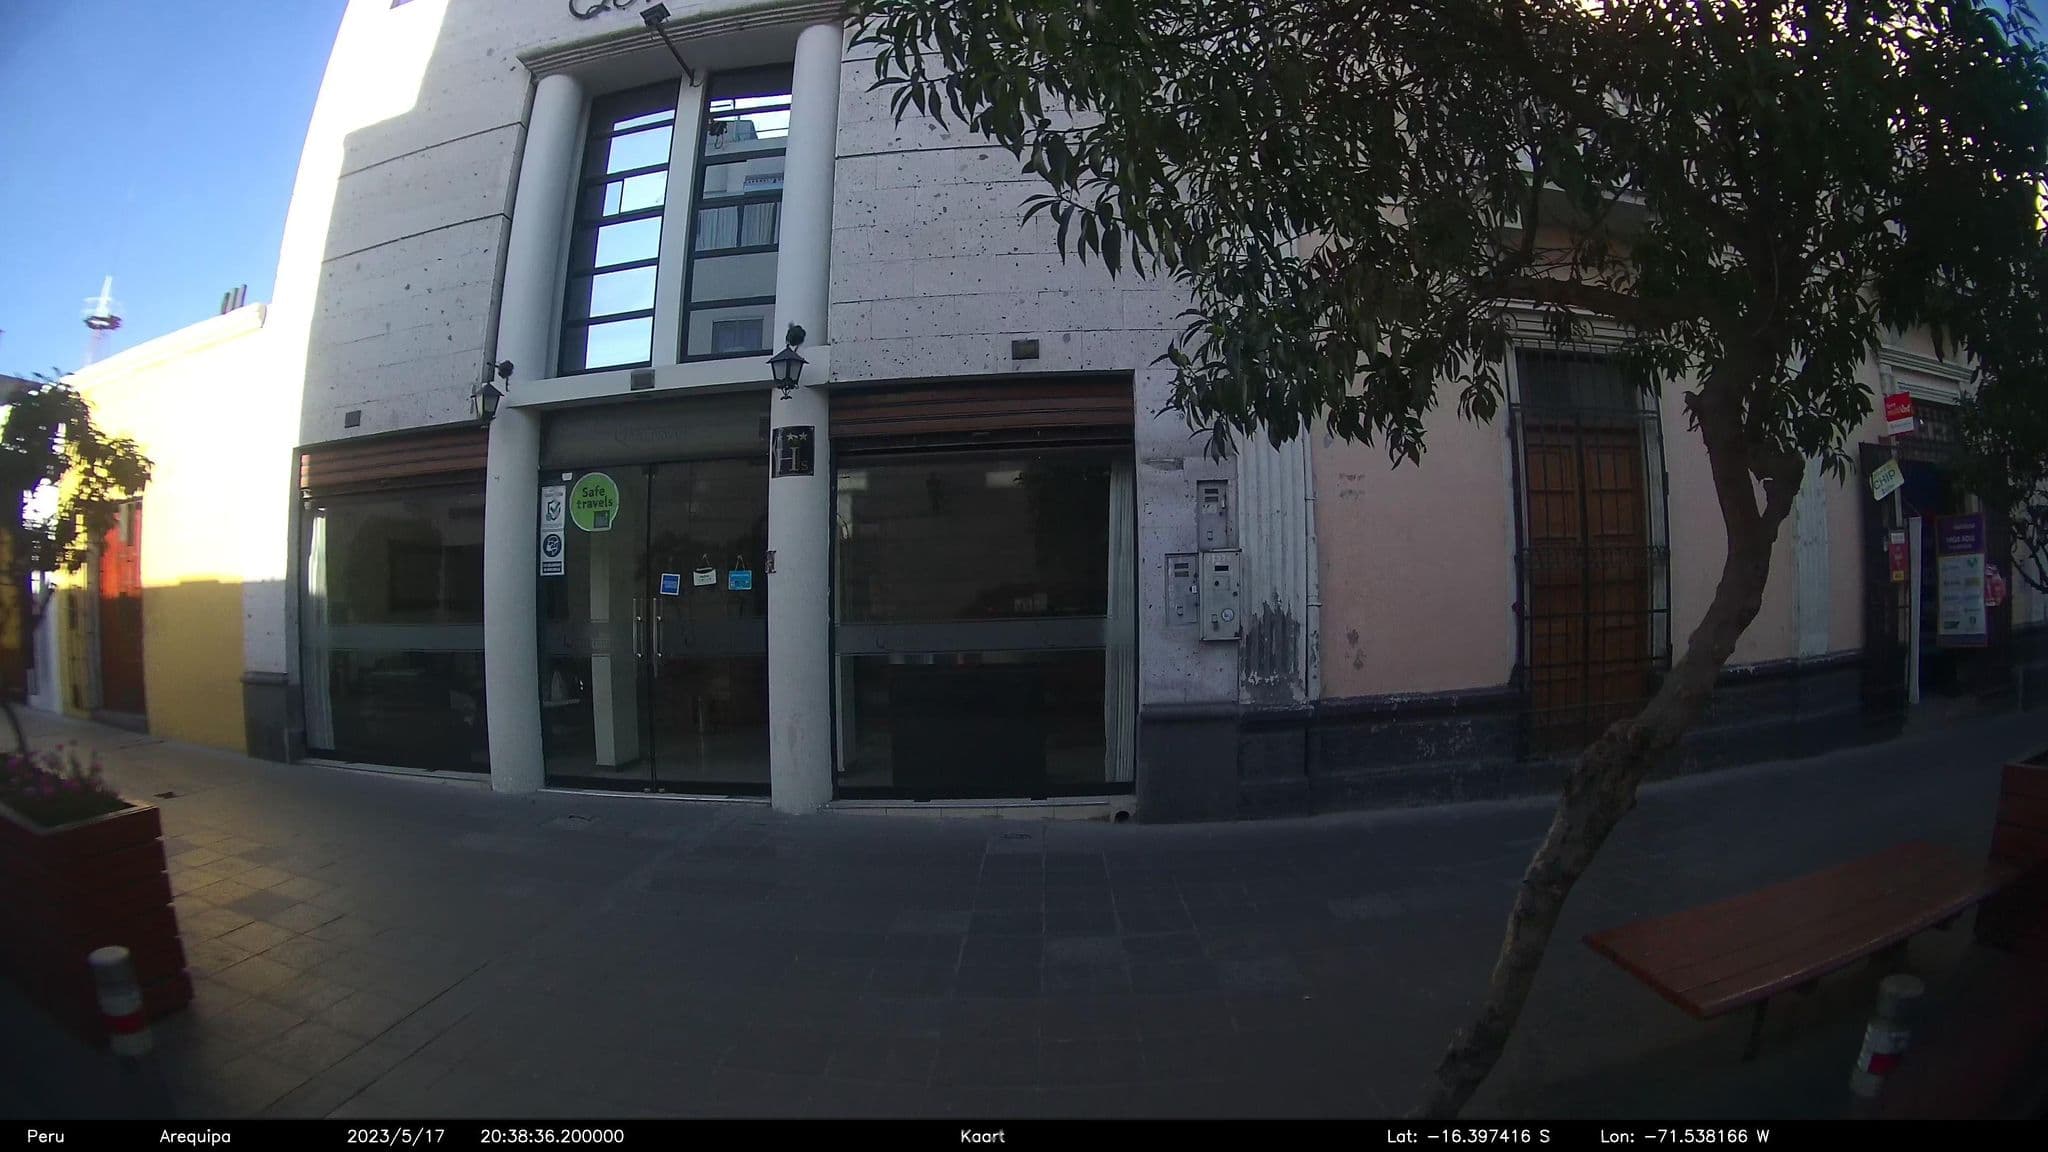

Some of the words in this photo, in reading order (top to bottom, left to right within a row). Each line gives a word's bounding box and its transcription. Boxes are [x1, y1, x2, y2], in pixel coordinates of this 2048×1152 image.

[1873, 469, 1896, 490] CHIP
[582, 485, 605, 497] Safe
[576, 496, 613, 509] travels
